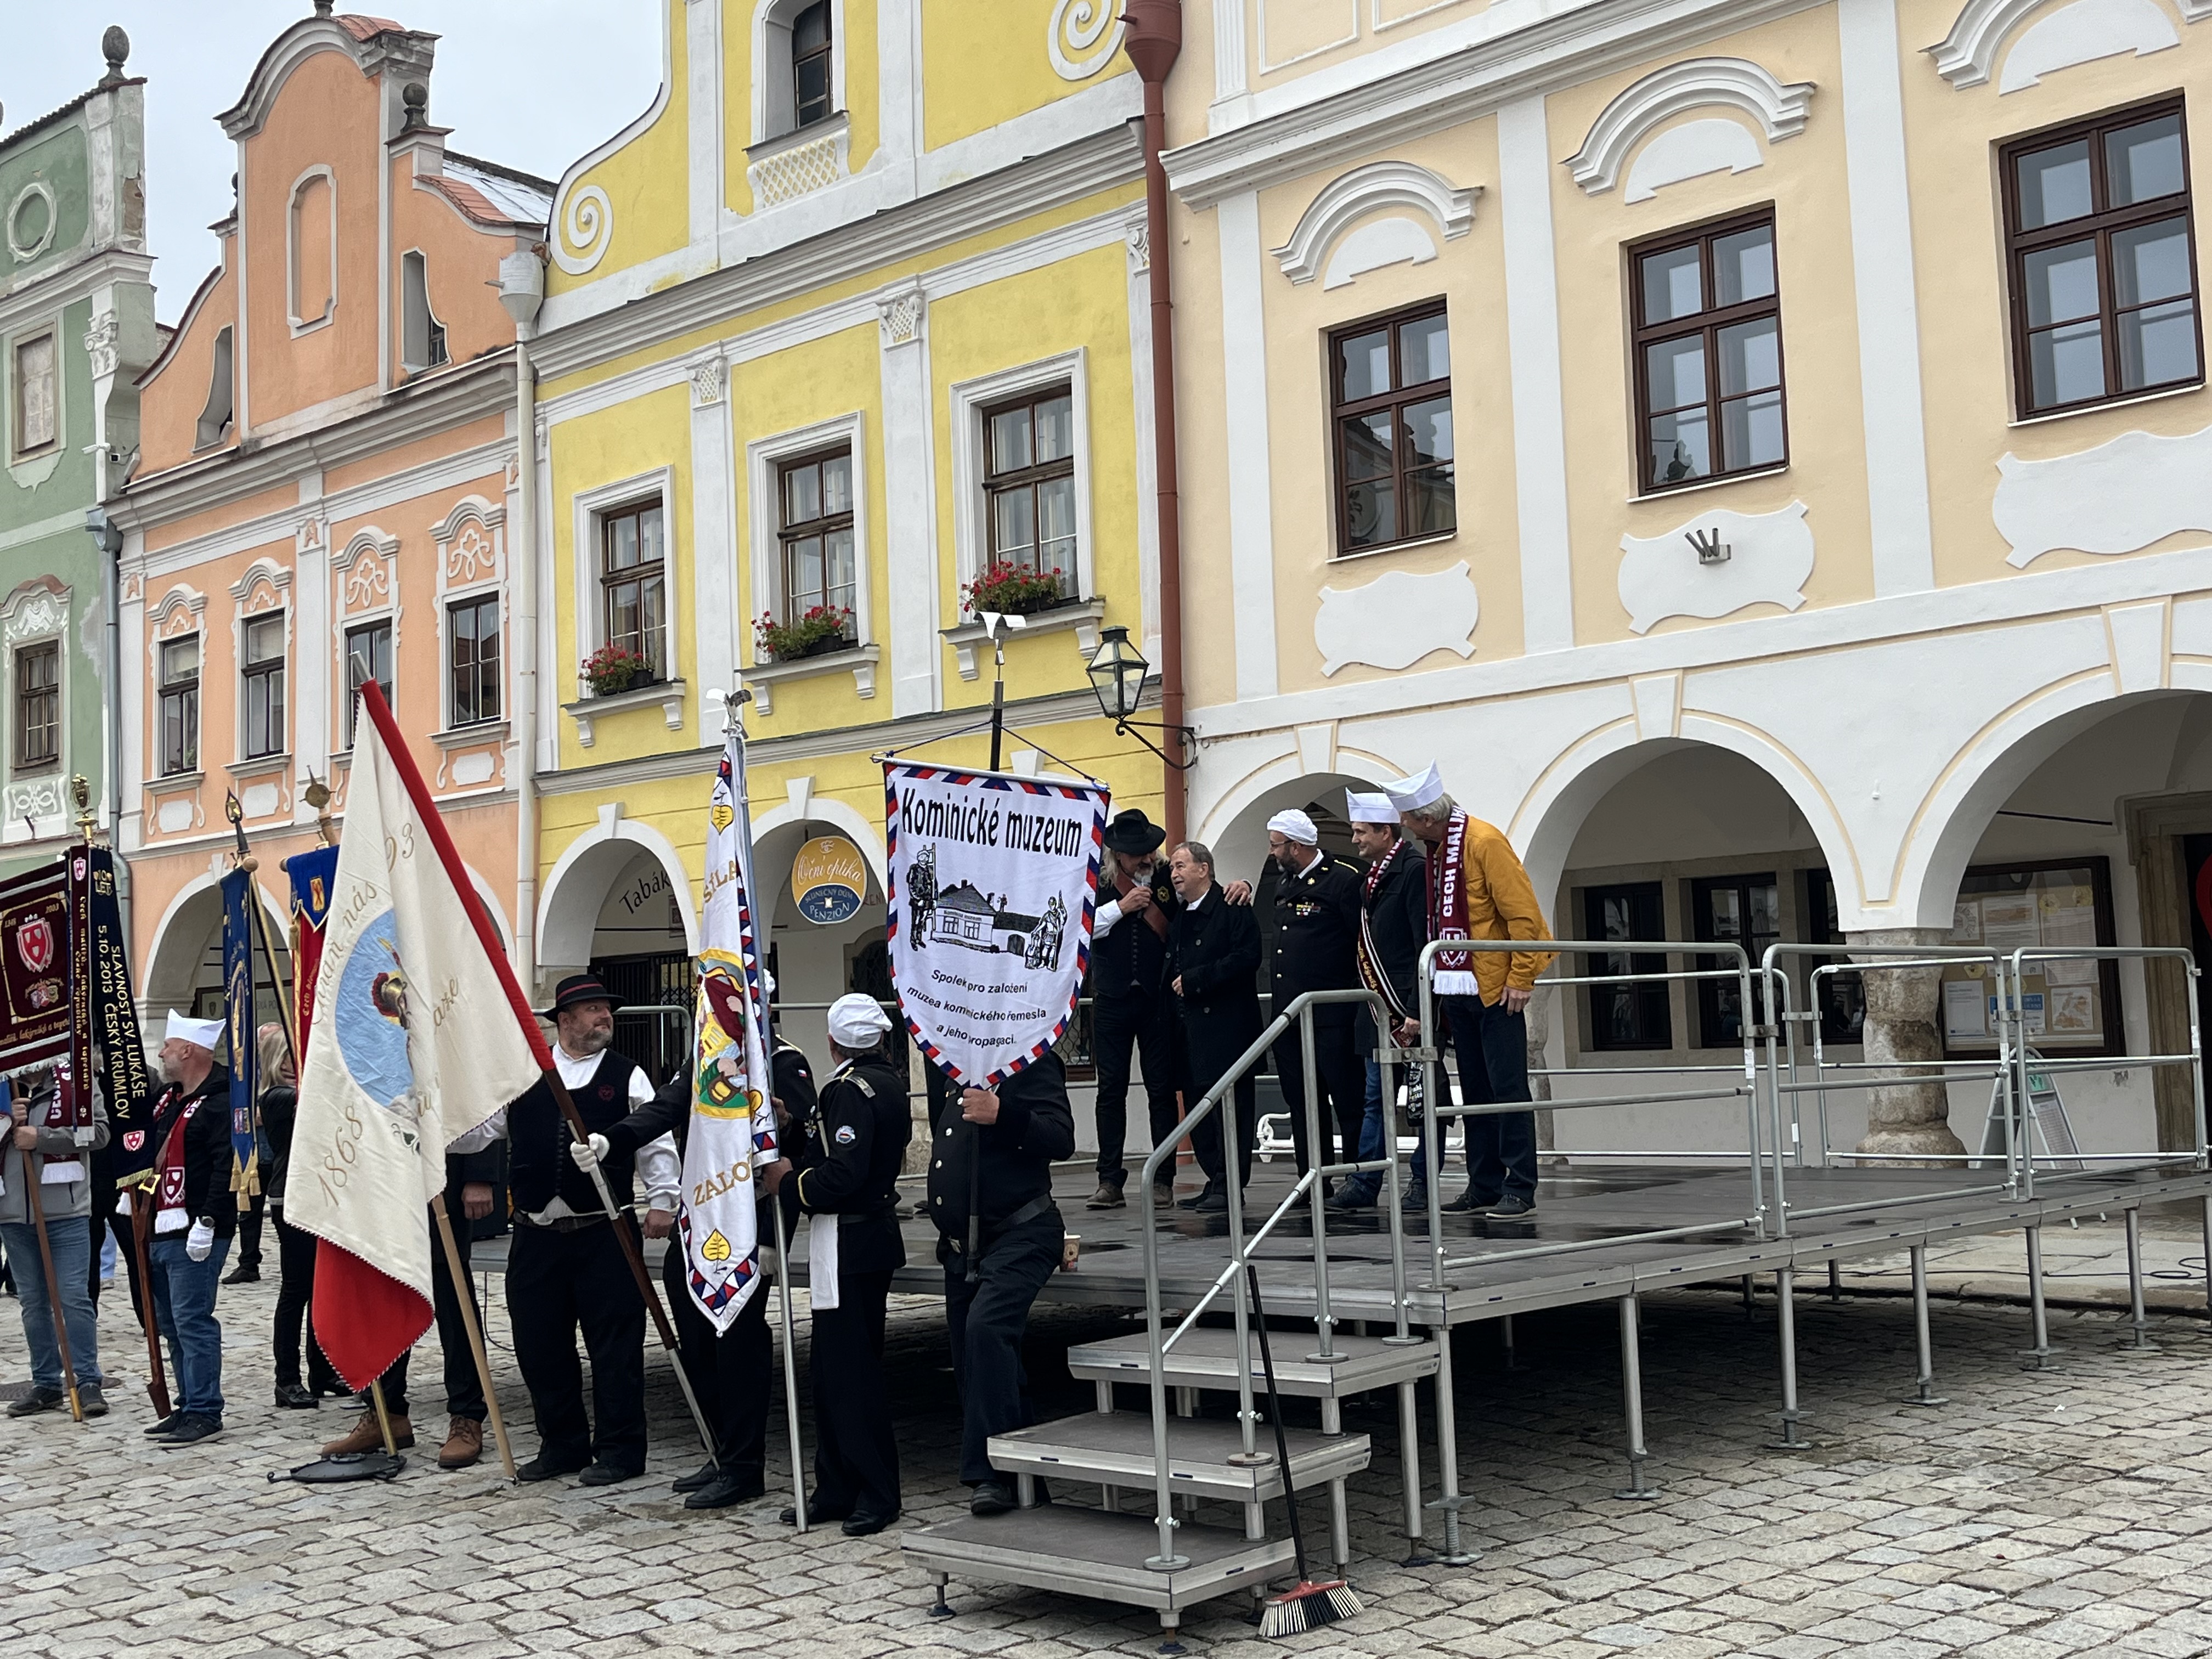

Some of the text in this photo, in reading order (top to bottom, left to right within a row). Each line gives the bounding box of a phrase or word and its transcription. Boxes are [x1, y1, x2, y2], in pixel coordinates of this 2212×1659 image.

[902, 788, 1082, 857] Kominické muzeum
[619, 870, 670, 914] Tabák
[798, 855, 862, 885] Oční optika
[809, 902, 850, 921] PENZION
[1443, 868, 1457, 917] CECH
[907, 986, 941, 1008] muzea
[932, 969, 967, 987] Spolek
[967, 983, 985, 993] pro
[105, 1003, 124, 1047] ČESKÝ
[111, 946, 131, 1018] SLAVNOST
[127, 1045, 148, 1098] LUKÁŠE
[936, 1024, 944, 1032] a
[944, 1026, 968, 1040] jeho
[110, 1051, 131, 1119] KRUMLOV
[317, 1102, 363, 1207] 1868
